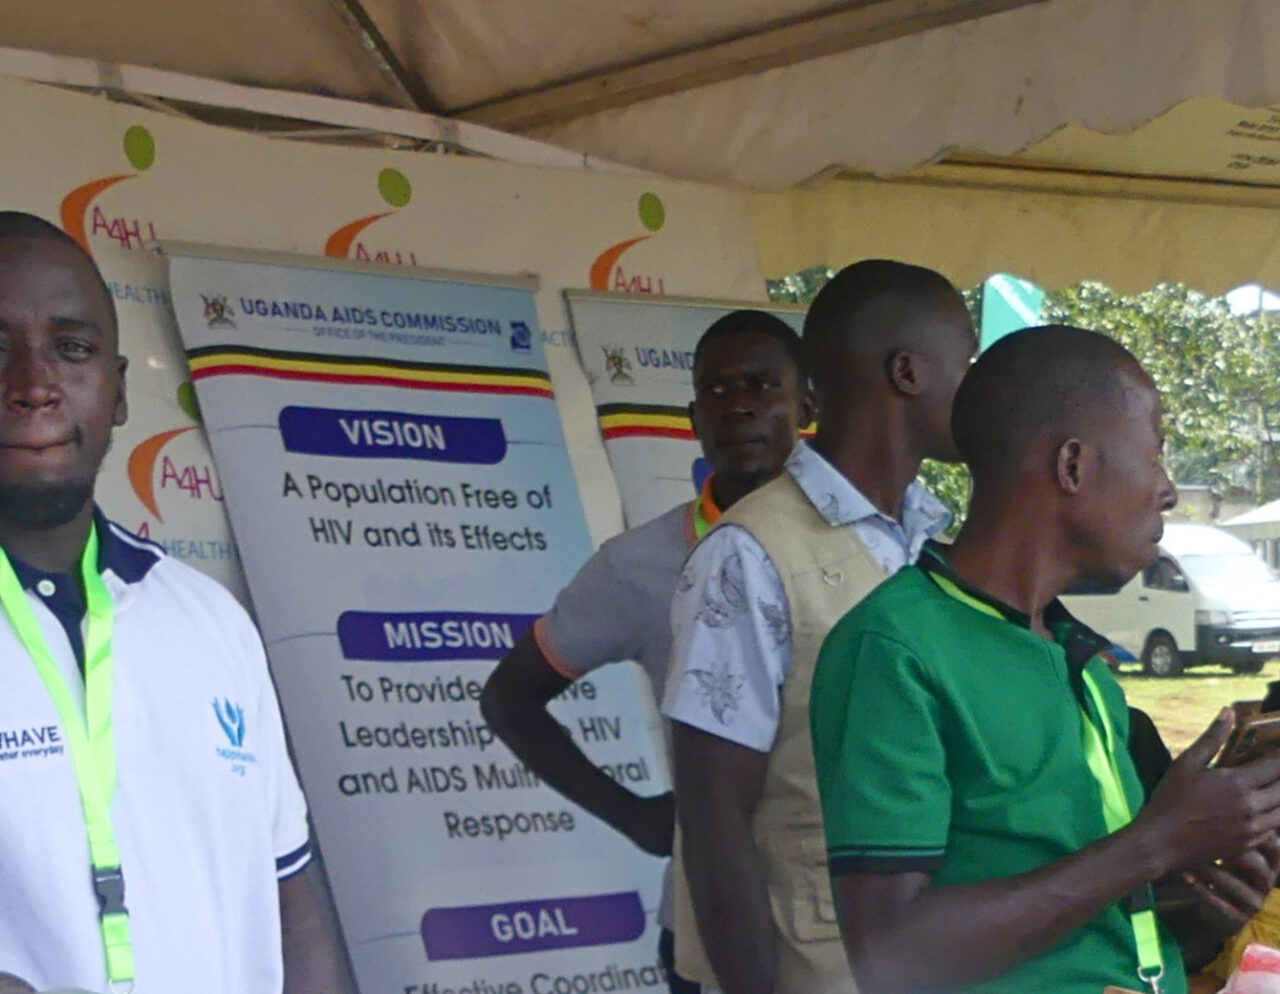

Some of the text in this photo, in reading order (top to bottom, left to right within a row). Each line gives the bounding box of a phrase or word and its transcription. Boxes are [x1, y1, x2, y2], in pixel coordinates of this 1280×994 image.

[239, 297, 502, 337] UGANDA AIDS COMMISSION
[339, 419, 446, 450] VISION
[282, 472, 553, 509] A Population Free of
[309, 517, 548, 551] HIV and its Effects
[383, 621, 515, 649] MISSION
[341, 675, 373, 701] To
[379, 676, 483, 703] Provide
[340, 717, 621, 751] Leadership HIV
[338, 768, 398, 796] and
[408, 765, 467, 794] AIDS
[444, 811, 575, 840] Response
[491, 908, 578, 943] GOAL
